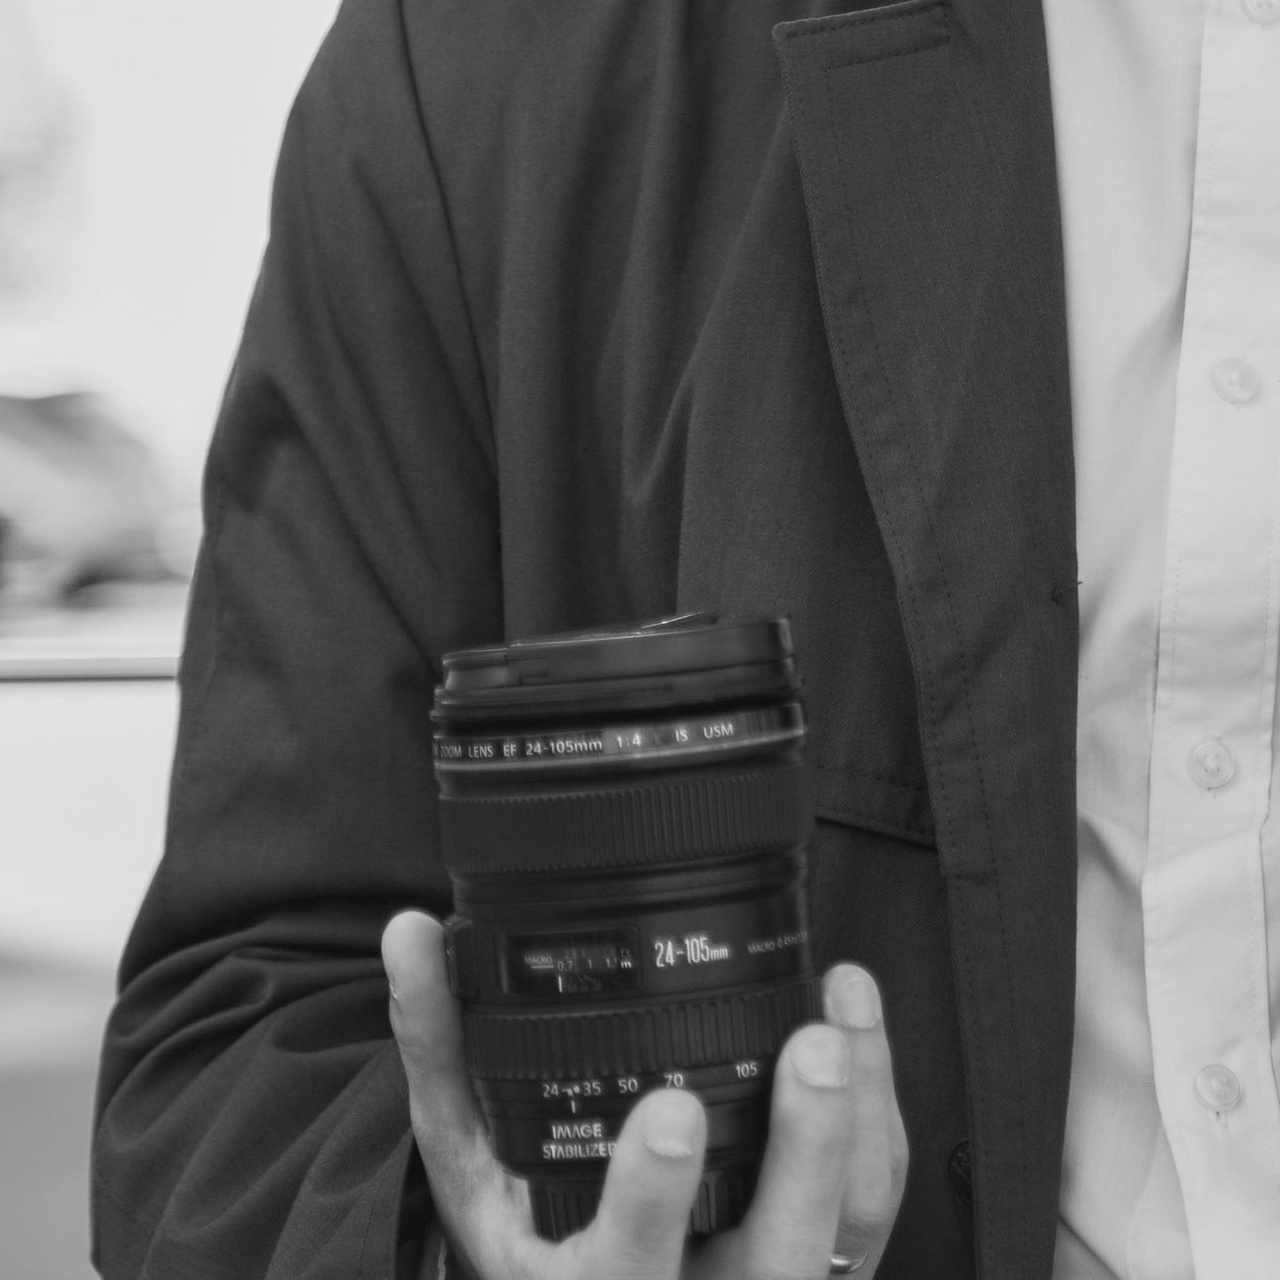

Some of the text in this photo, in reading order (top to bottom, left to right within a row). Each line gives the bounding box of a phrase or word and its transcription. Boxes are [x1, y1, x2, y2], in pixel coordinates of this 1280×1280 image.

[440, 745, 462, 758] ZOOM
[468, 744, 494, 758] LENS
[503, 743, 517, 757] EF
[525, 739, 603, 756] 24-105mm
[616, 732, 642, 749] 1:4
[675, 728, 689, 742] IS
[702, 721, 733, 739] USM
[654, 936, 729, 968] 24-105mm
[542, 1061, 758, 1098] 24 35 50 70 105
[551, 1123, 603, 1139] IMAGE
